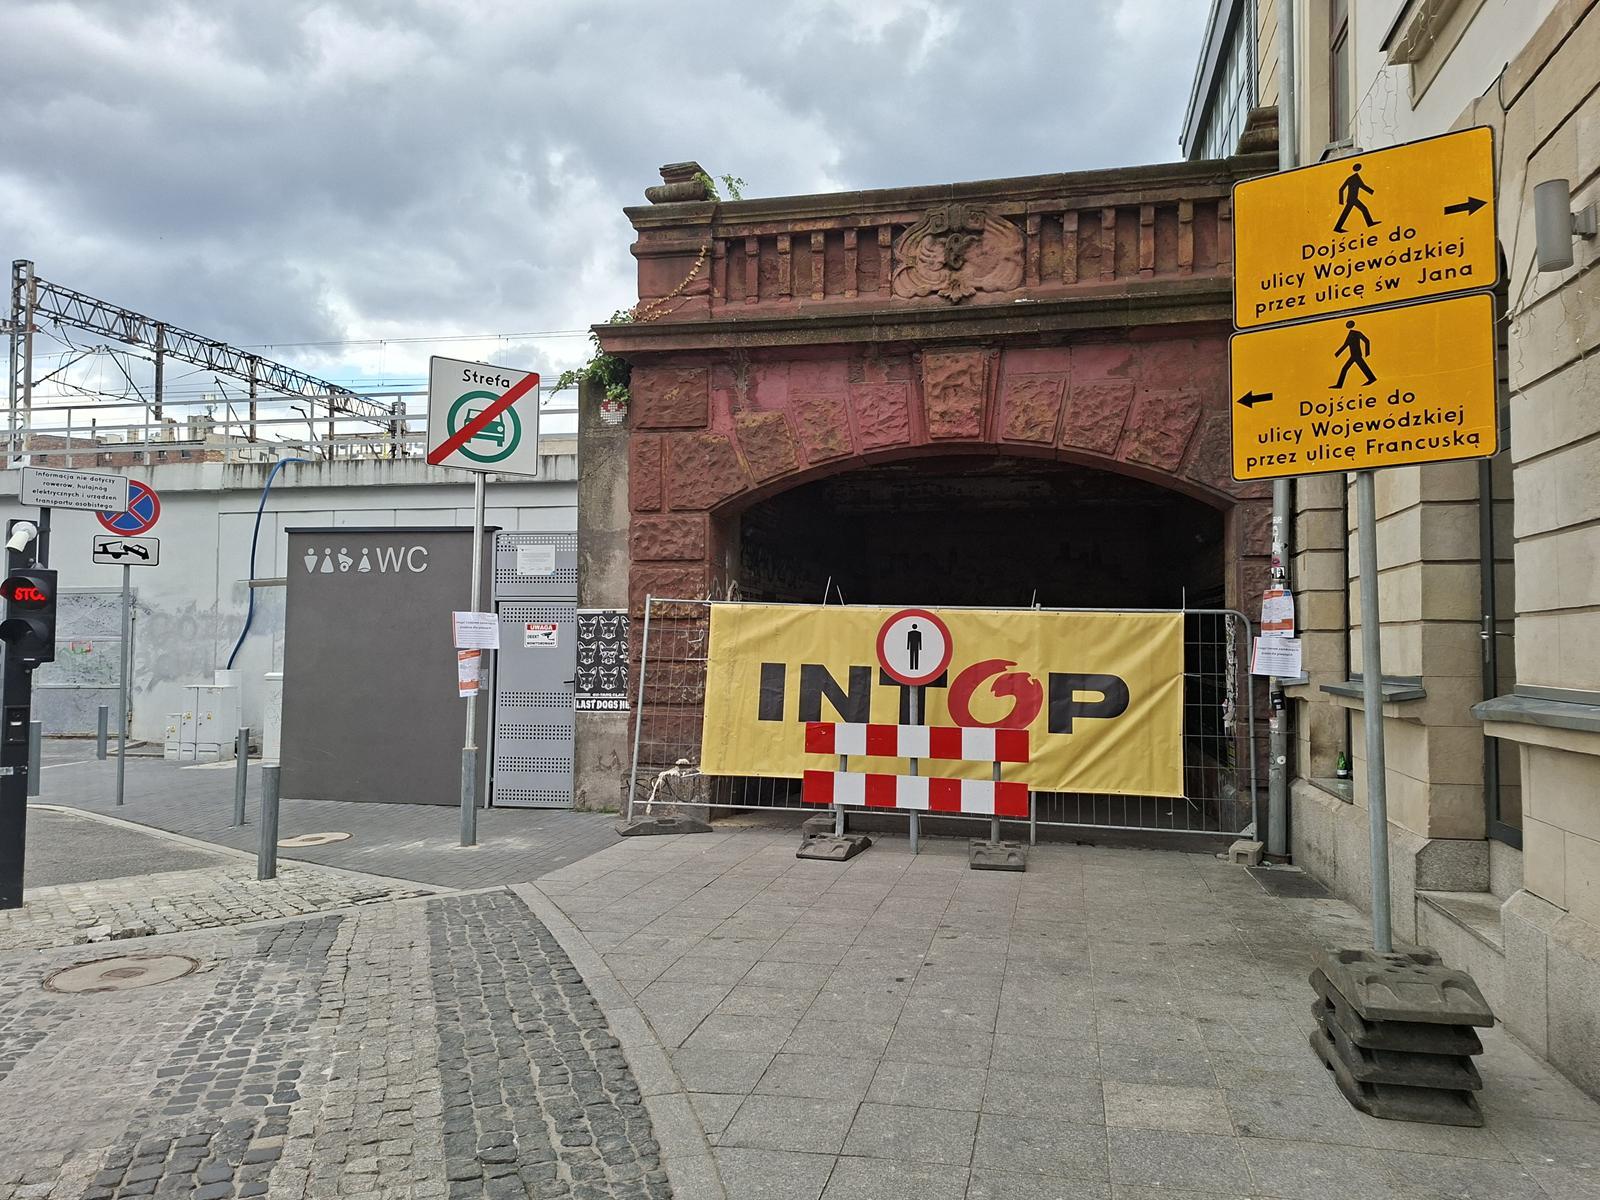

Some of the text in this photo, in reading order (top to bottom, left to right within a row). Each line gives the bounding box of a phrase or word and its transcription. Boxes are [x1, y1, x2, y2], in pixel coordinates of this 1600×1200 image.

[1302, 226, 1417, 260] Dojście do
[1261, 237, 1465, 291] ulicy Wojewódzkiej
[1255, 264, 1473, 318] przez ulicę św Jana
[462, 368, 511, 389] Strefa
[1300, 389, 1416, 418] Dojście do
[1258, 405, 1465, 446] ulicy Wojewódzkiej
[1246, 430, 1481, 472] przez ulicę Francuską
[35, 471, 74, 480] Informacja
[89, 475, 116, 484] dotyczy
[32, 488, 80, 498] elektrycznych
[35, 498, 113, 510] transportu osobistego
[376, 546, 429, 573] WC
[576, 699, 596, 709] LAST
[596, 699, 618, 709] DOGS
